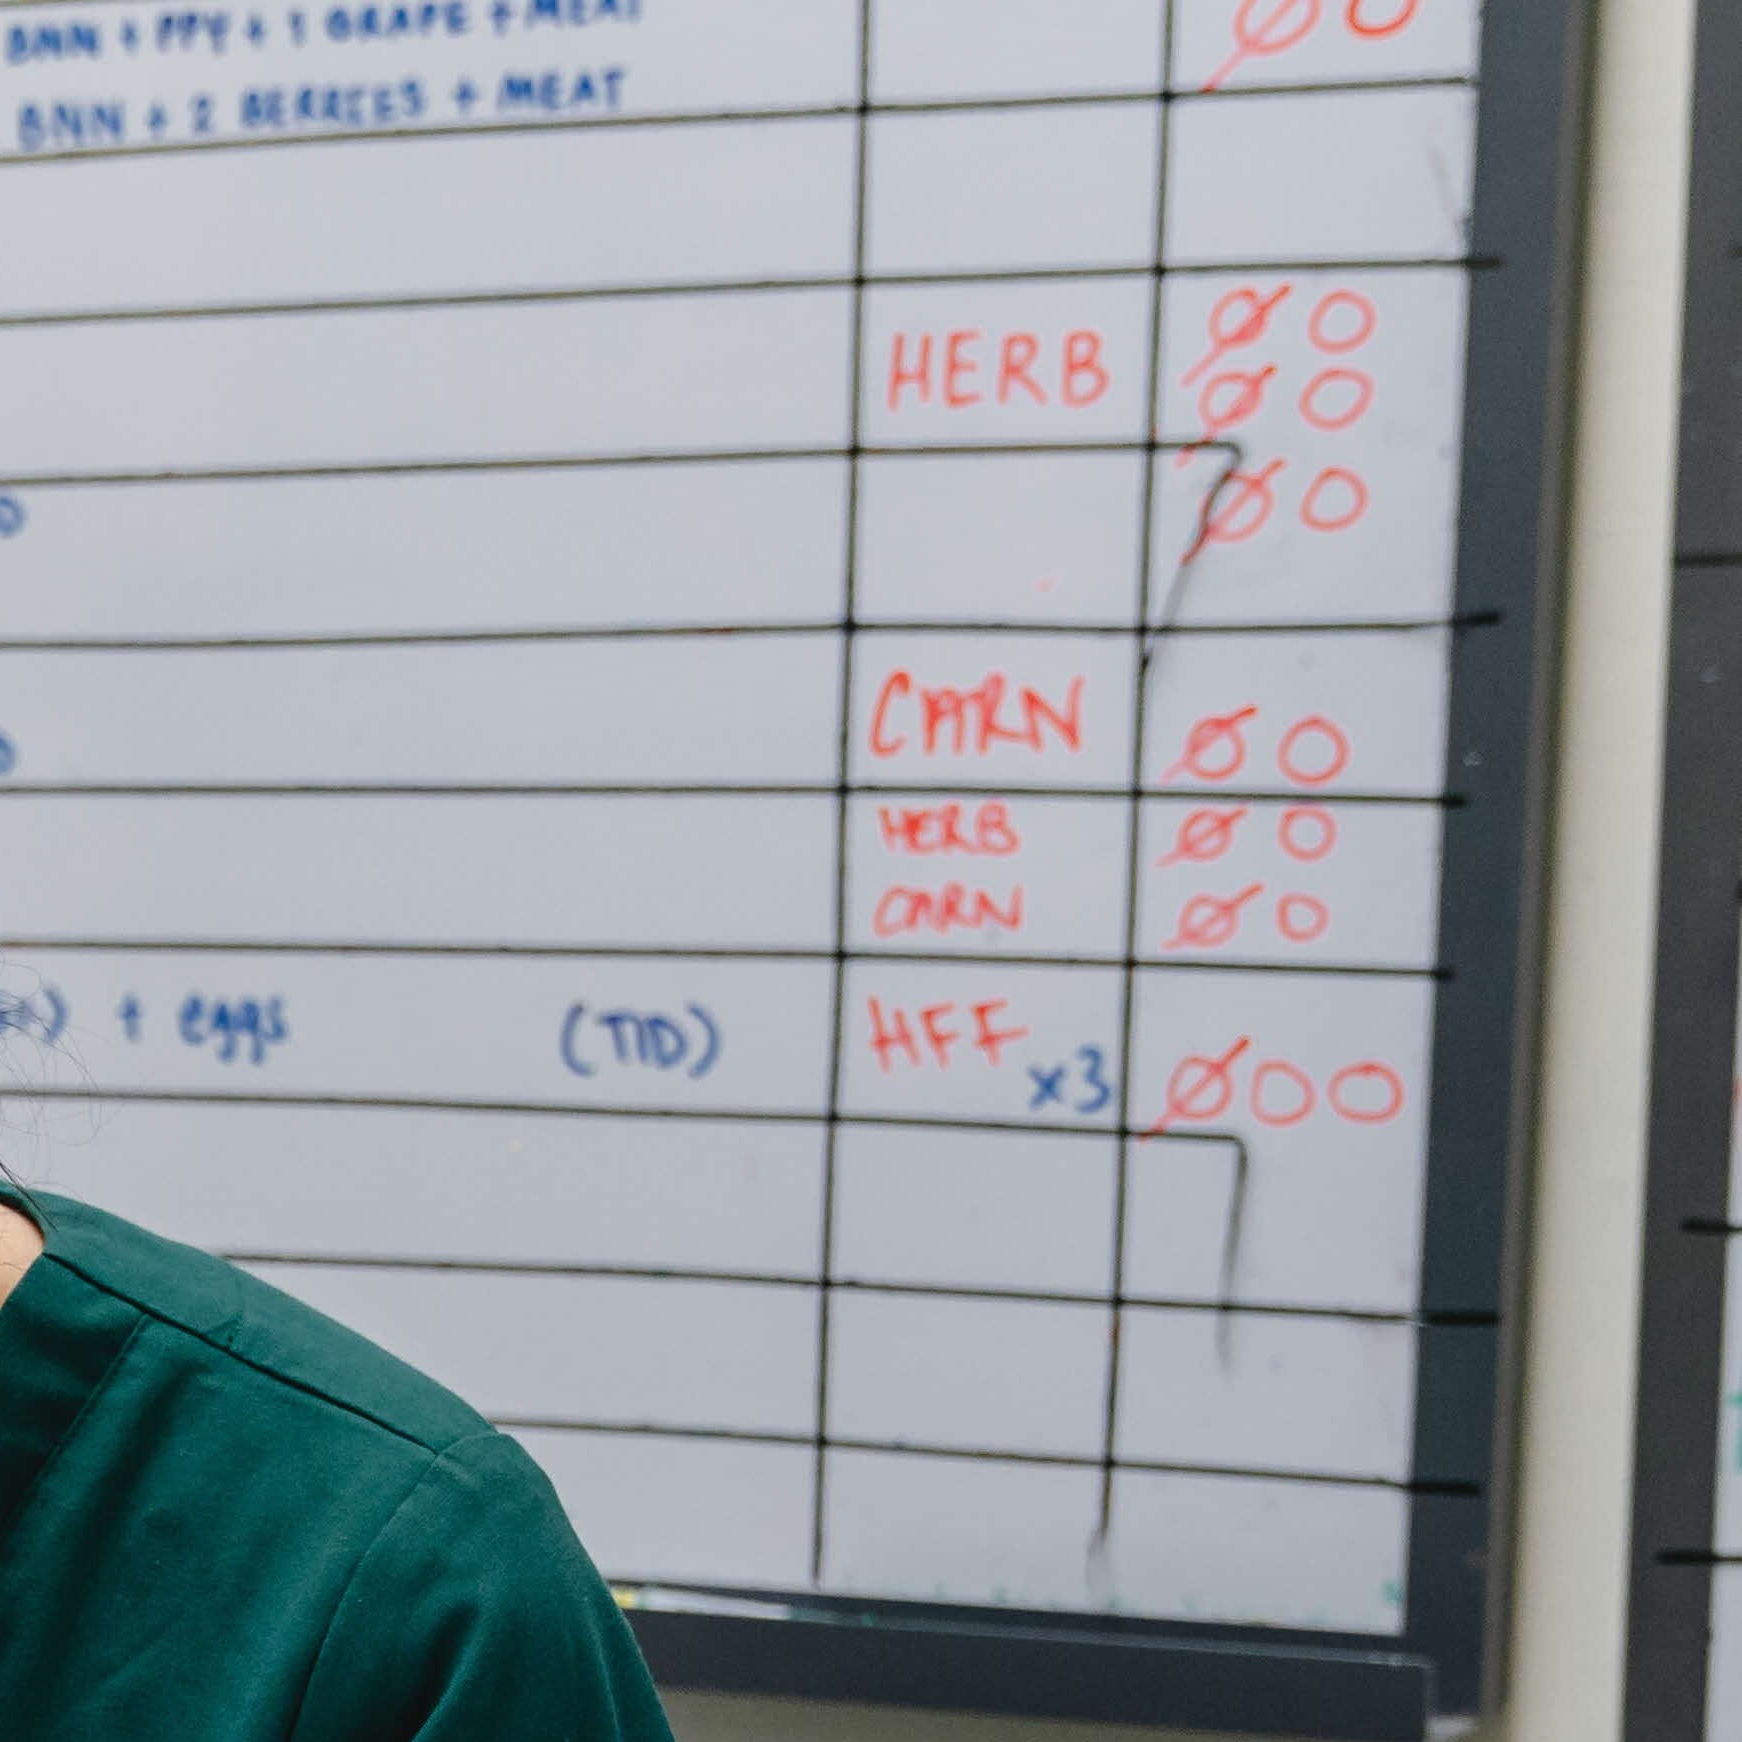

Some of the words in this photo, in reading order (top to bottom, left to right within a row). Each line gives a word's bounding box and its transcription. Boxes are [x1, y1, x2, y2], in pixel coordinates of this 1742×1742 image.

[495, 66, 627, 112] MEAT
[884, 327, 1113, 412] HERB
[877, 804, 1021, 856] HERB
[867, 996, 1029, 1074] HFF
